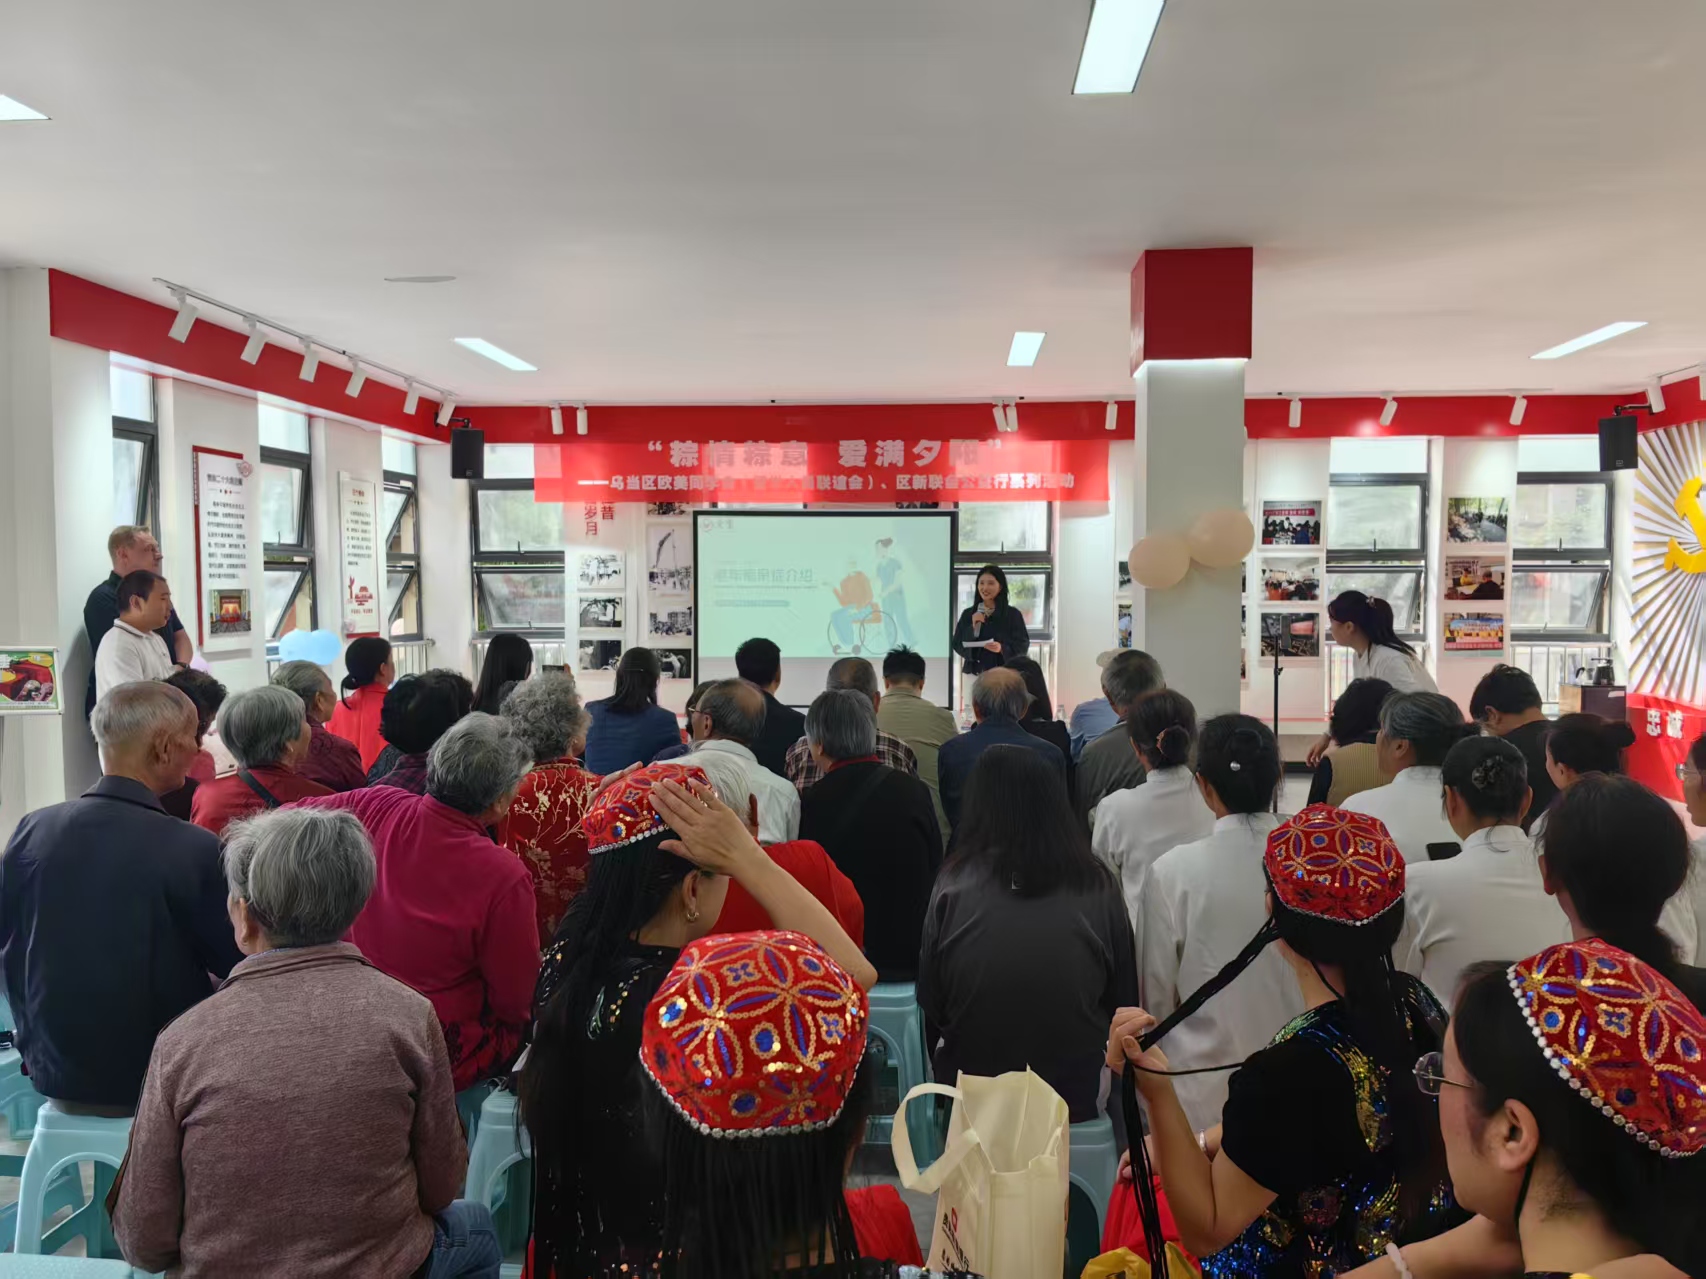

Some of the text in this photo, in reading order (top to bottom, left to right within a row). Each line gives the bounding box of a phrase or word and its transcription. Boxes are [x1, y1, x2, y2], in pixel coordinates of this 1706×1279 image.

[584, 501, 598, 536] 岁月
[600, 501, 616, 521] 昔
[1646, 708, 1684, 739] 忠诚
